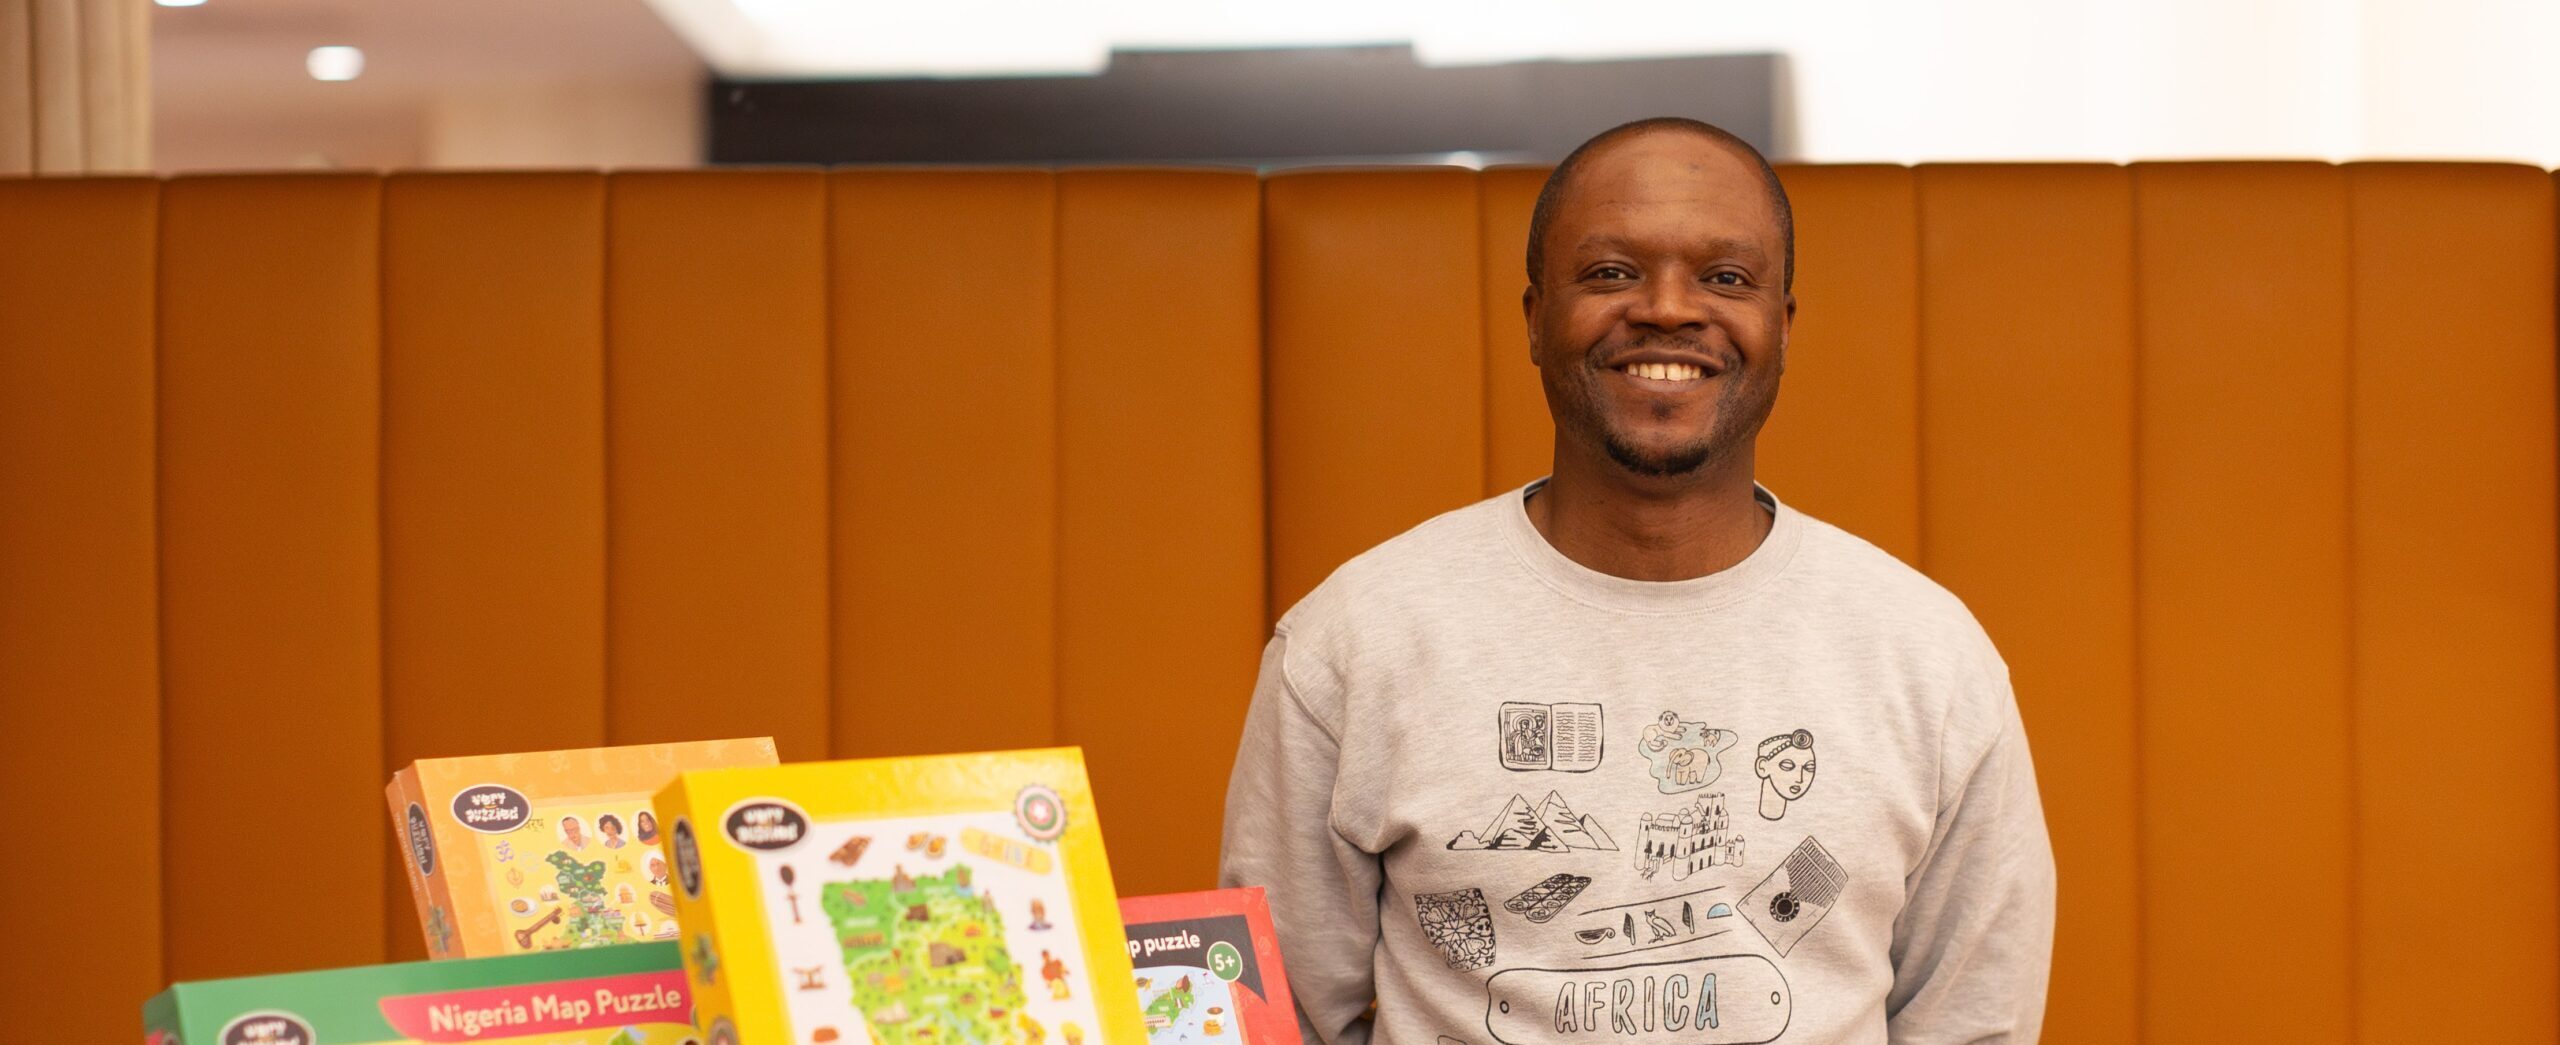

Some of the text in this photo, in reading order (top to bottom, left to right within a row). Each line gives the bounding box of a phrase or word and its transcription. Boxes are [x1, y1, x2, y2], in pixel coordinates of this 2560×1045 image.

[1144, 929, 1200, 957] puzzle
[1214, 952, 1235, 971] 5+
[428, 984, 682, 1036] Nigeria Map Puzzle
[1554, 972, 1719, 1036] AFRICA
